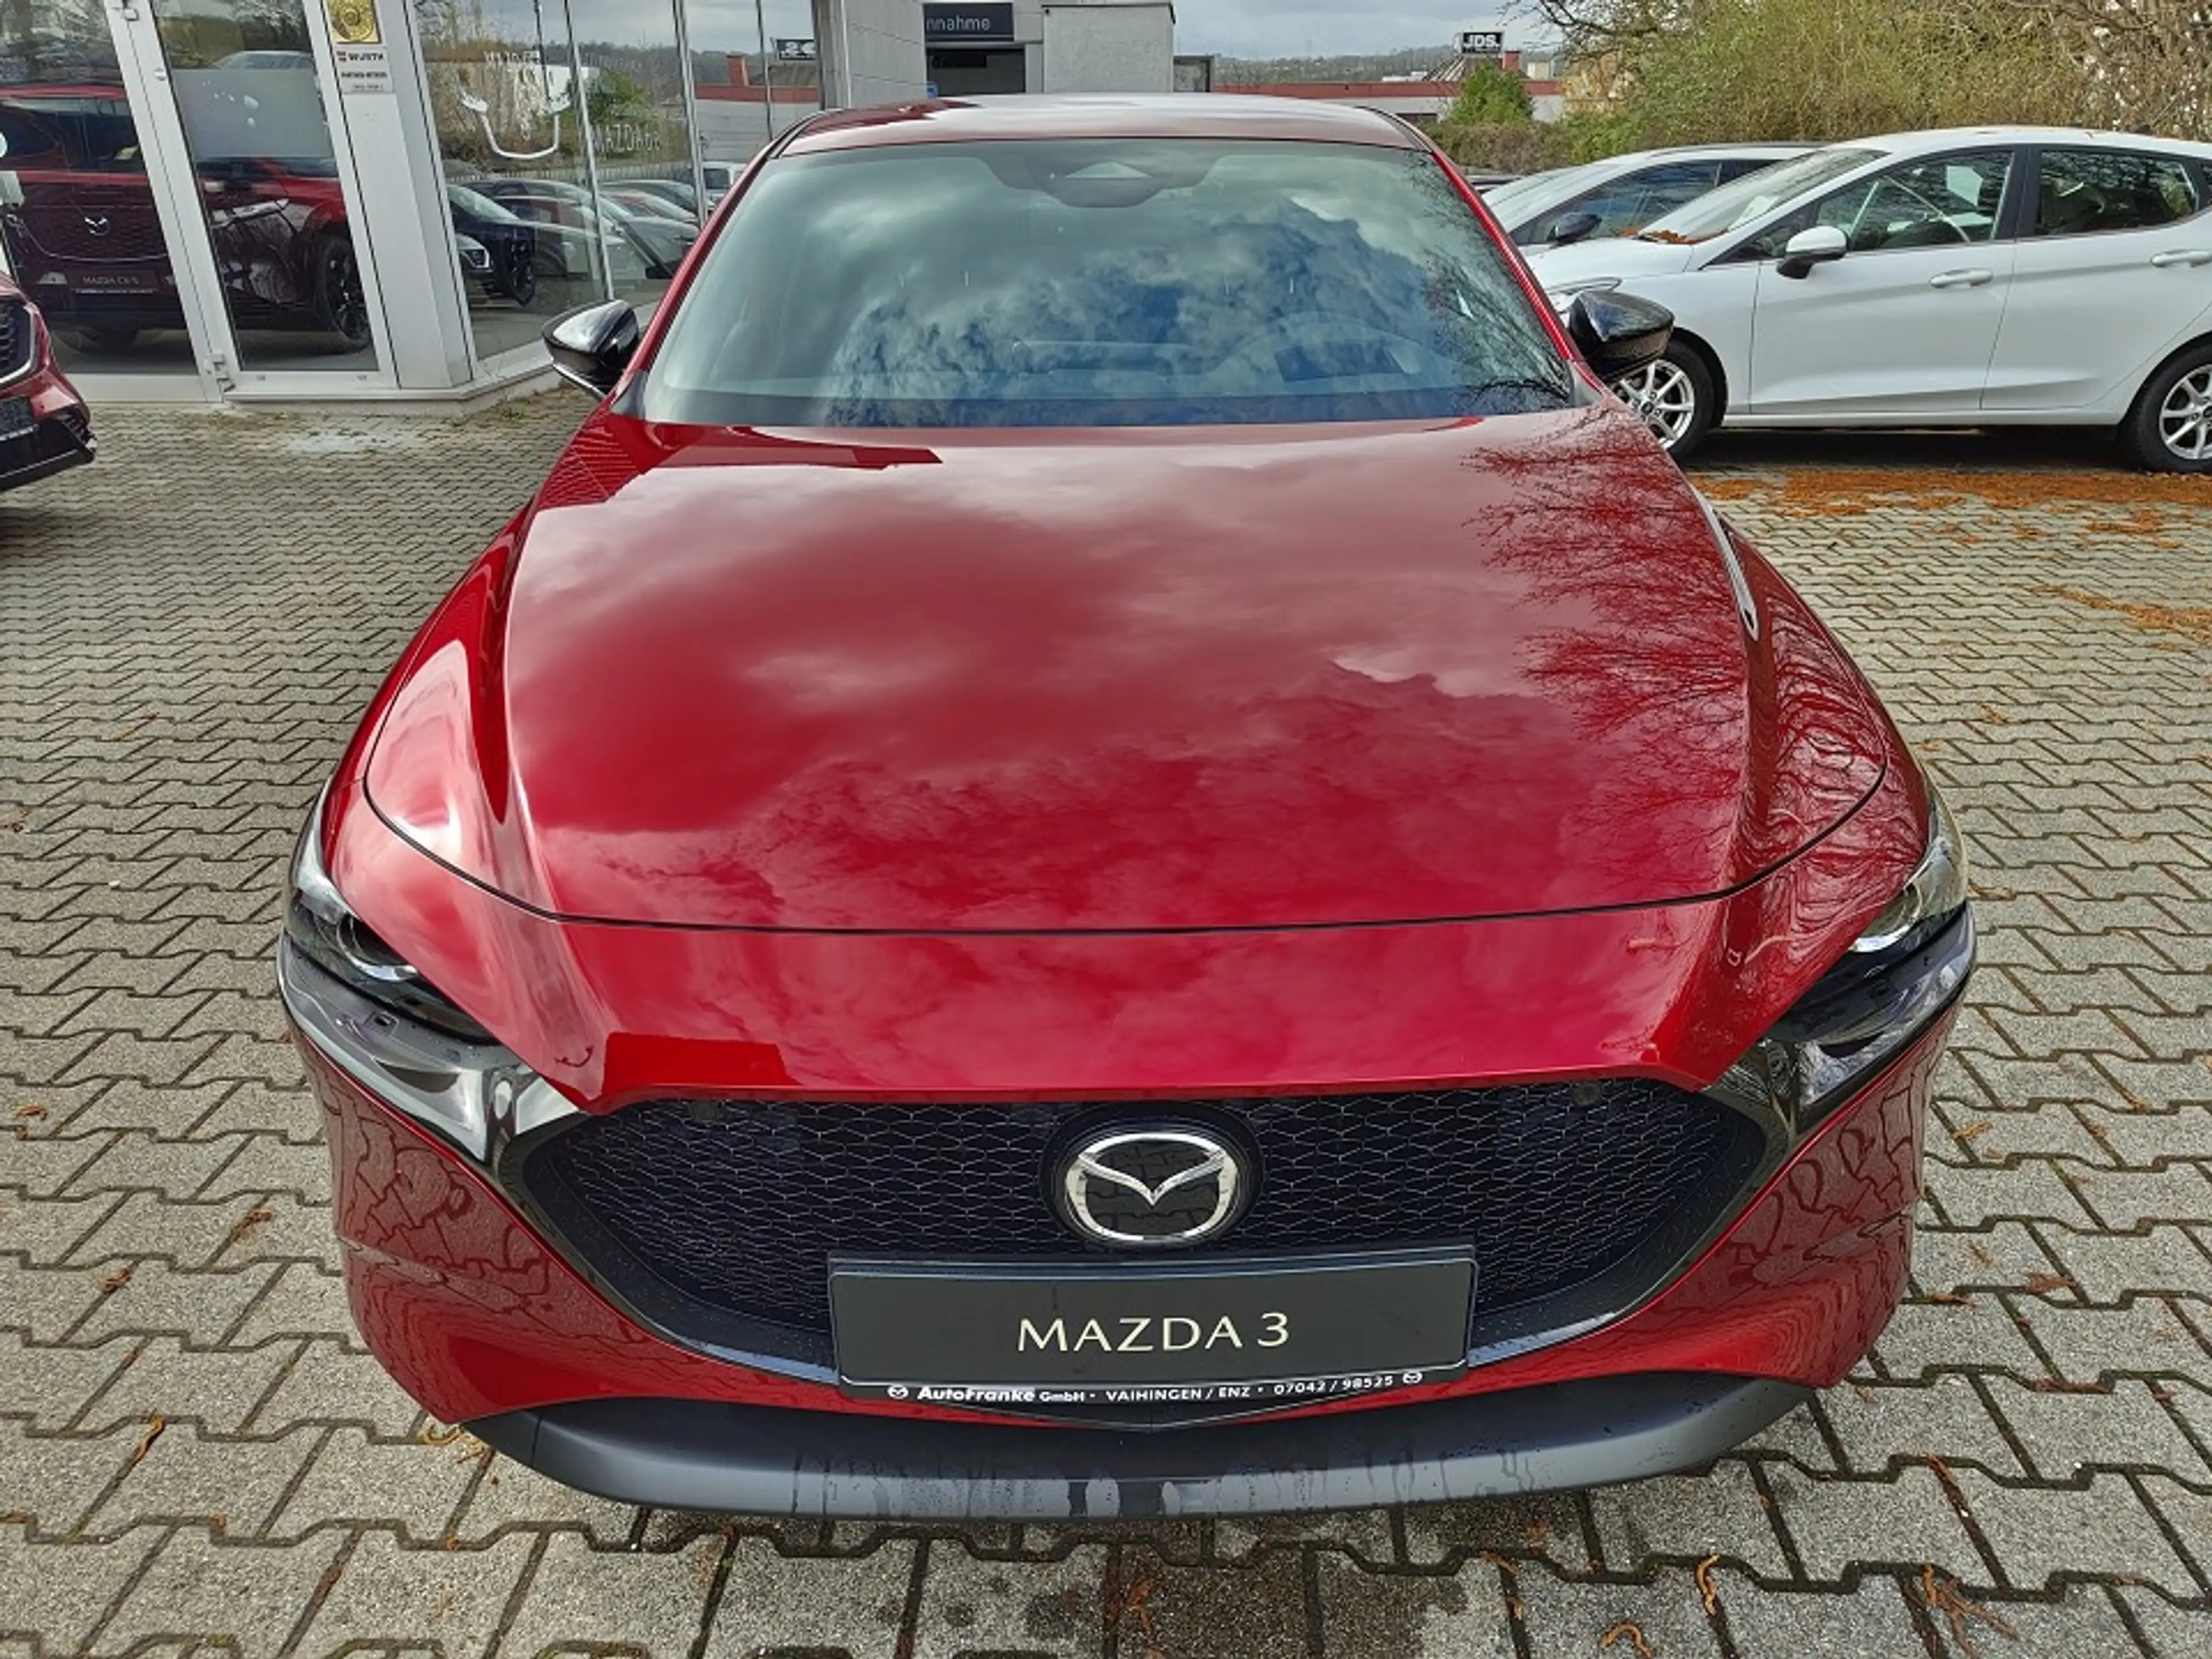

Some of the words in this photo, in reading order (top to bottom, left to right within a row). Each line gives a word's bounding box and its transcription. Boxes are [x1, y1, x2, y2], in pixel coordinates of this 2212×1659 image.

[1017, 1315, 1243, 1352] MAZDA
[1257, 1312, 1289, 1347] 3
[1039, 1391, 1084, 1402] GmbH
[1105, 1389, 1202, 1402] VAIHINGEN
[1218, 1387, 1249, 1397] ENZ
[1274, 1381, 1325, 1395] 07042
